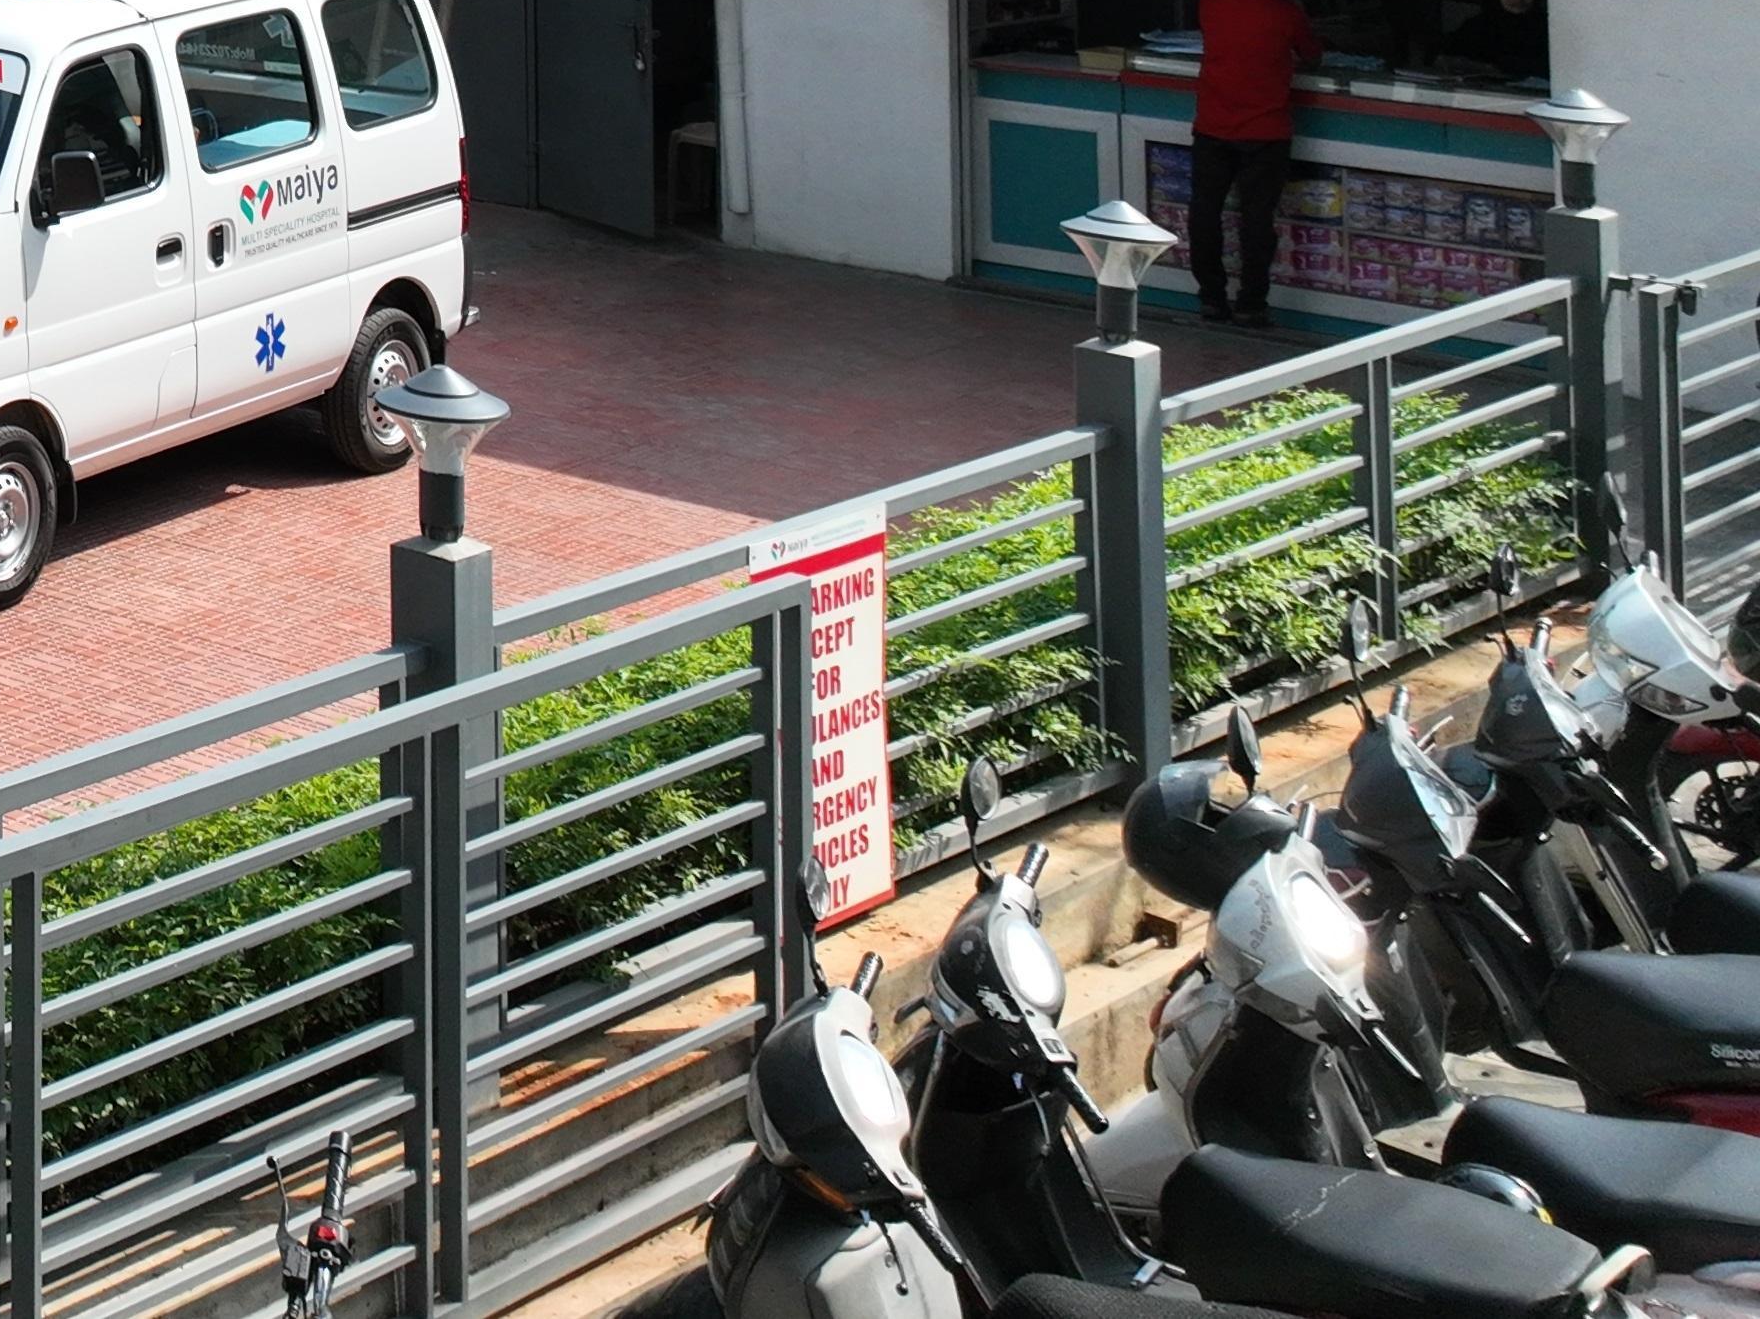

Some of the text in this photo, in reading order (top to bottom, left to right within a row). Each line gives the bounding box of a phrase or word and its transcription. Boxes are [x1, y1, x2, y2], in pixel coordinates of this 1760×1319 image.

[277, 164, 338, 206] Maiya
[242, 207, 340, 245] MULTI SPECIALITY HOSPITAL
[811, 567, 874, 615] ARKING
[811, 616, 855, 659] CEPT
[812, 690, 880, 745] LANCES
[813, 776, 877, 831] RGENCY
[813, 823, 869, 869] ICLES
[829, 874, 850, 910] LY
